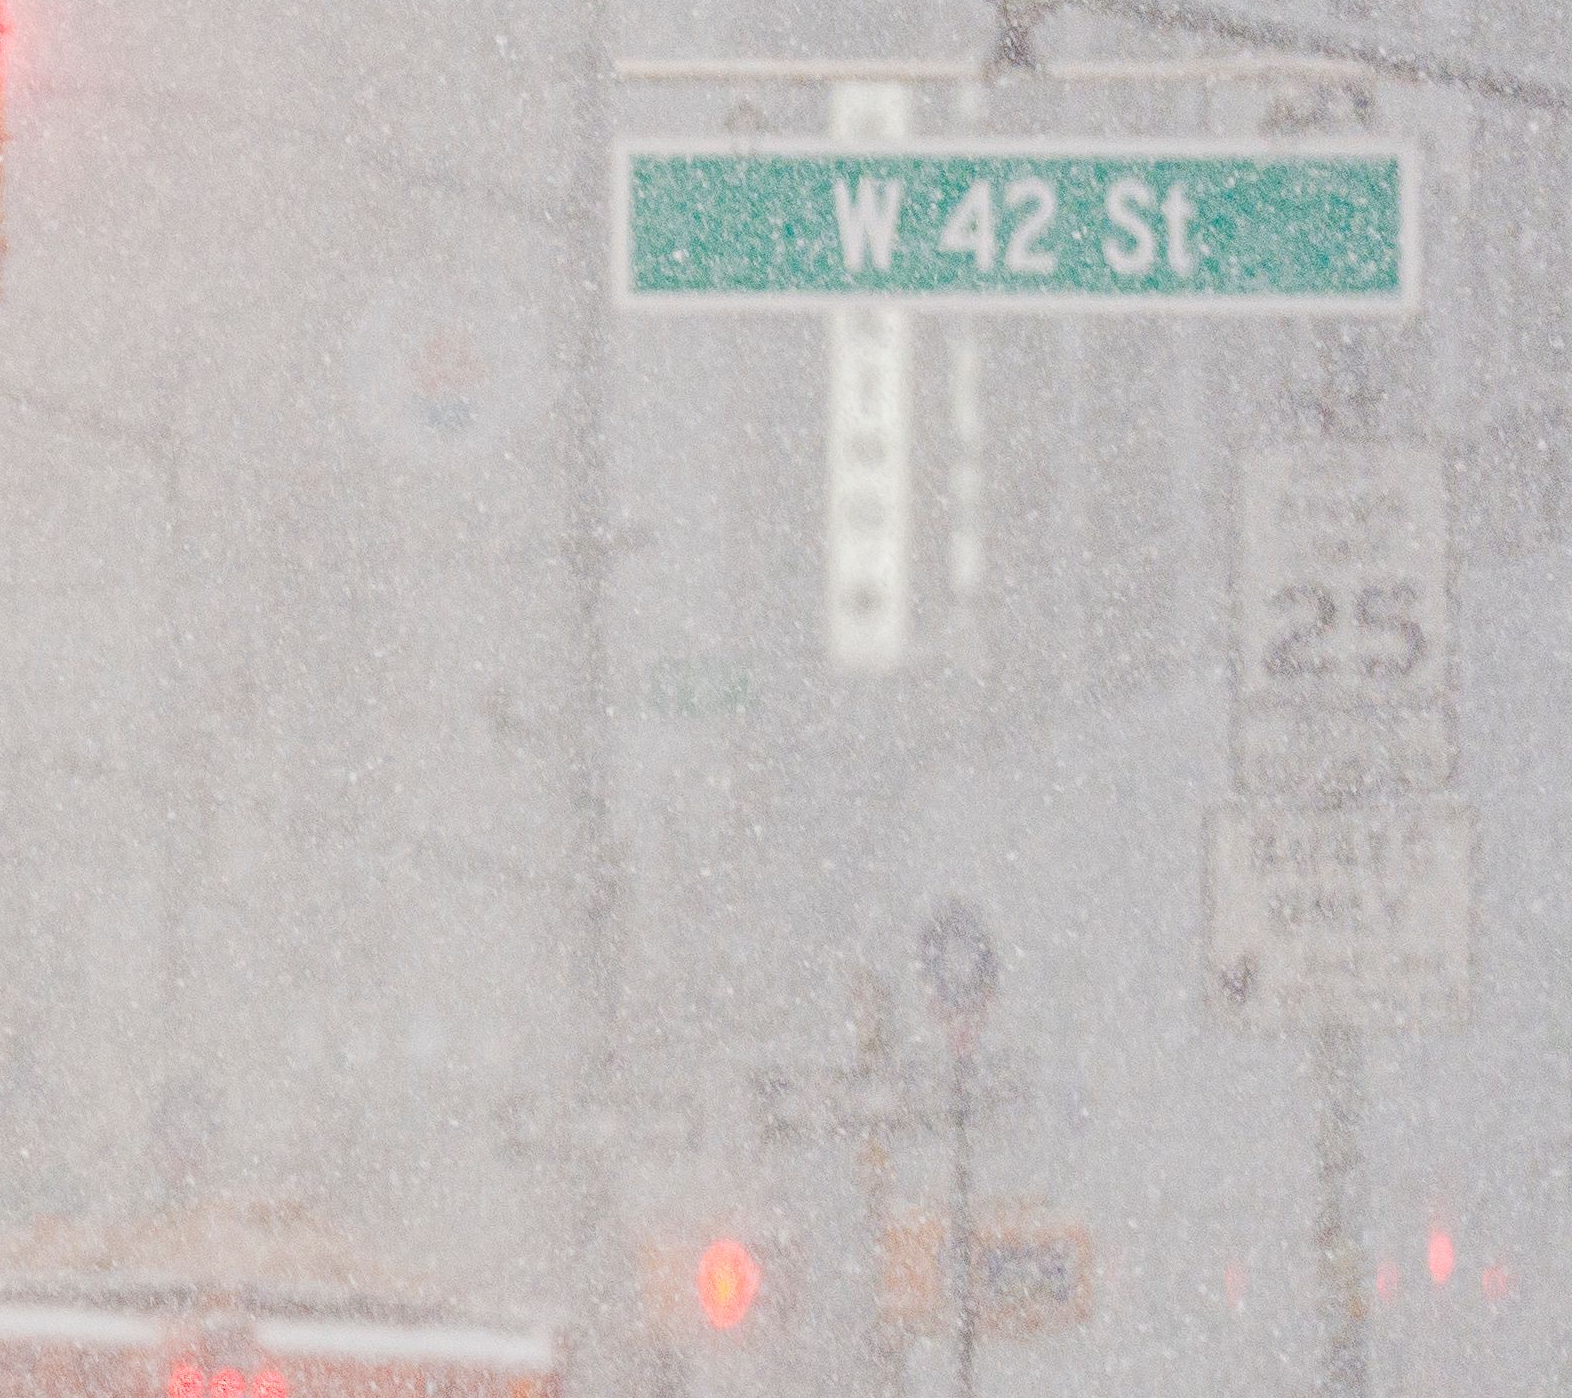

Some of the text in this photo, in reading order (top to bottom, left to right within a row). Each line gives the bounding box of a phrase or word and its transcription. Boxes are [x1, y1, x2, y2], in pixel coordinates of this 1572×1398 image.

[831, 175, 1196, 277] W 42 St
[1264, 581, 1429, 681] 25
